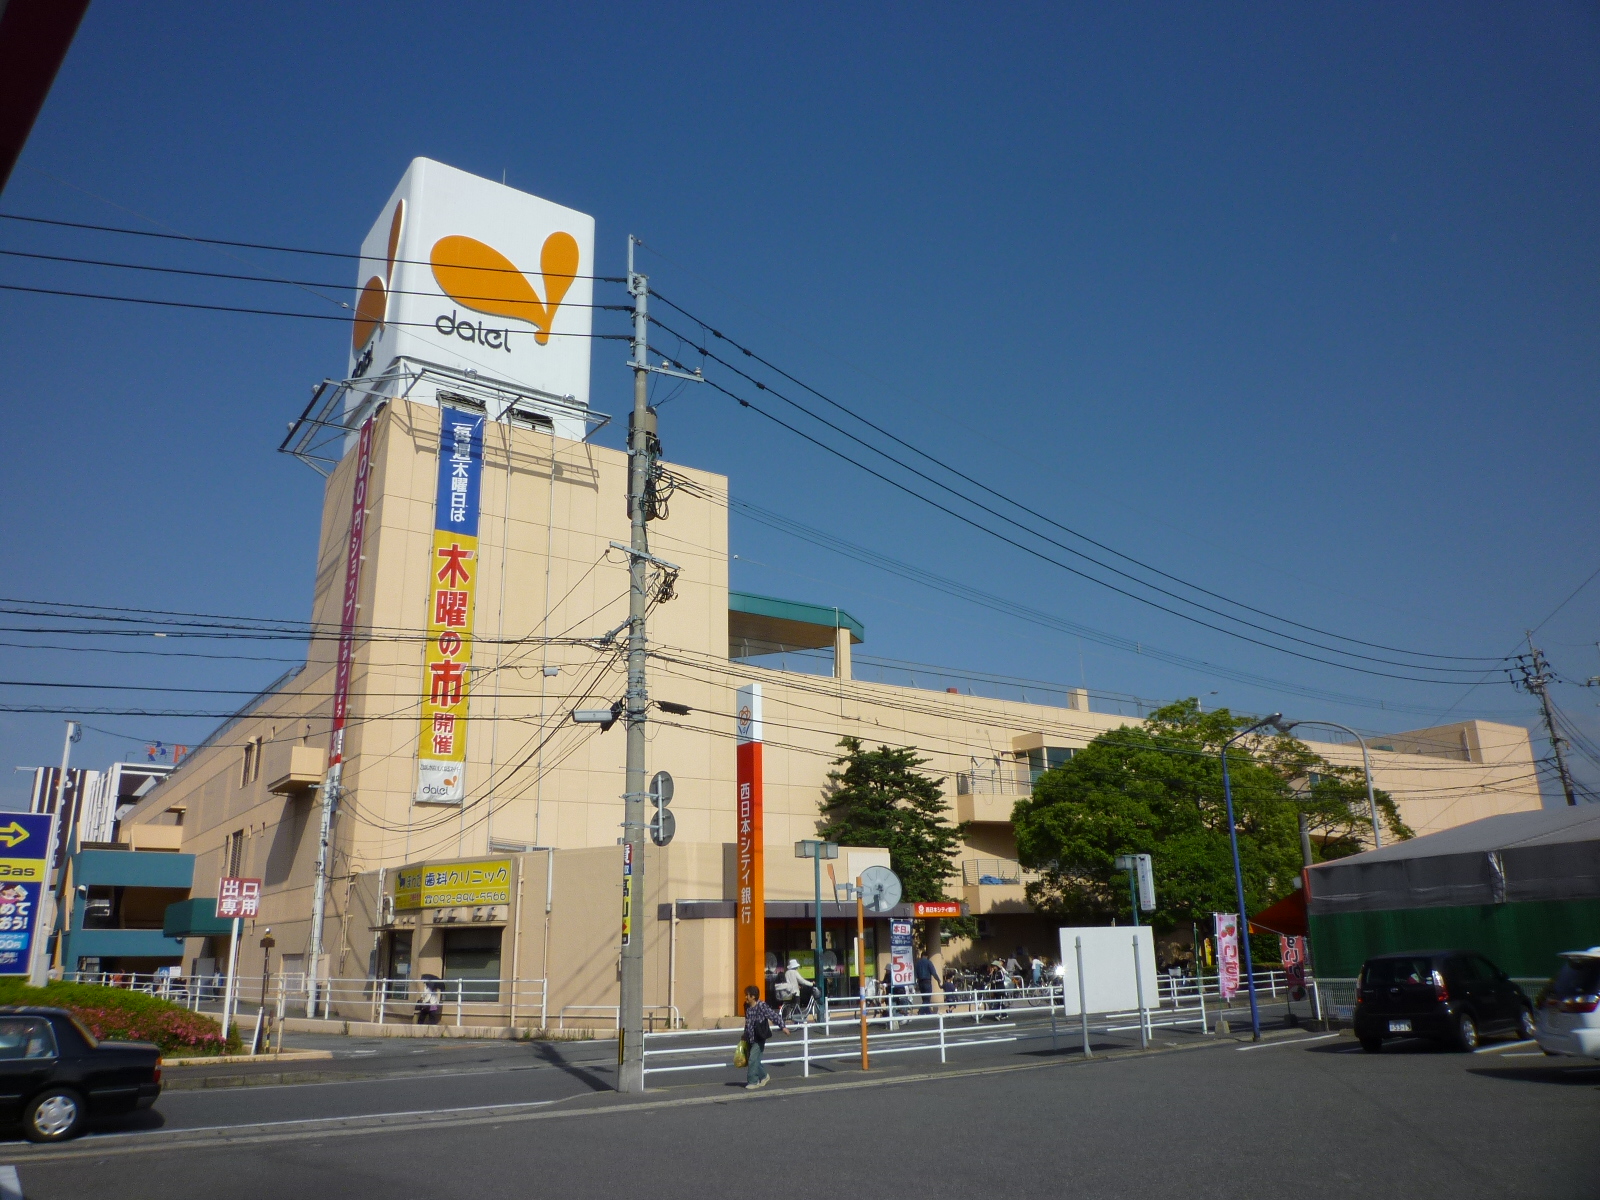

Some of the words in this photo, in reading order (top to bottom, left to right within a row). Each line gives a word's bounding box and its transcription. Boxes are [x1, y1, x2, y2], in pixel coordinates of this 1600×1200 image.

[435, 309, 512, 353] daiei
[422, 783, 450, 796] daiei
[739, 782, 753, 924] 西日本シティ銀行
[222, 879, 259, 897] 出口
[433, 891, 508, 904] 092-894-5566
[220, 898, 257, 915] 専用
